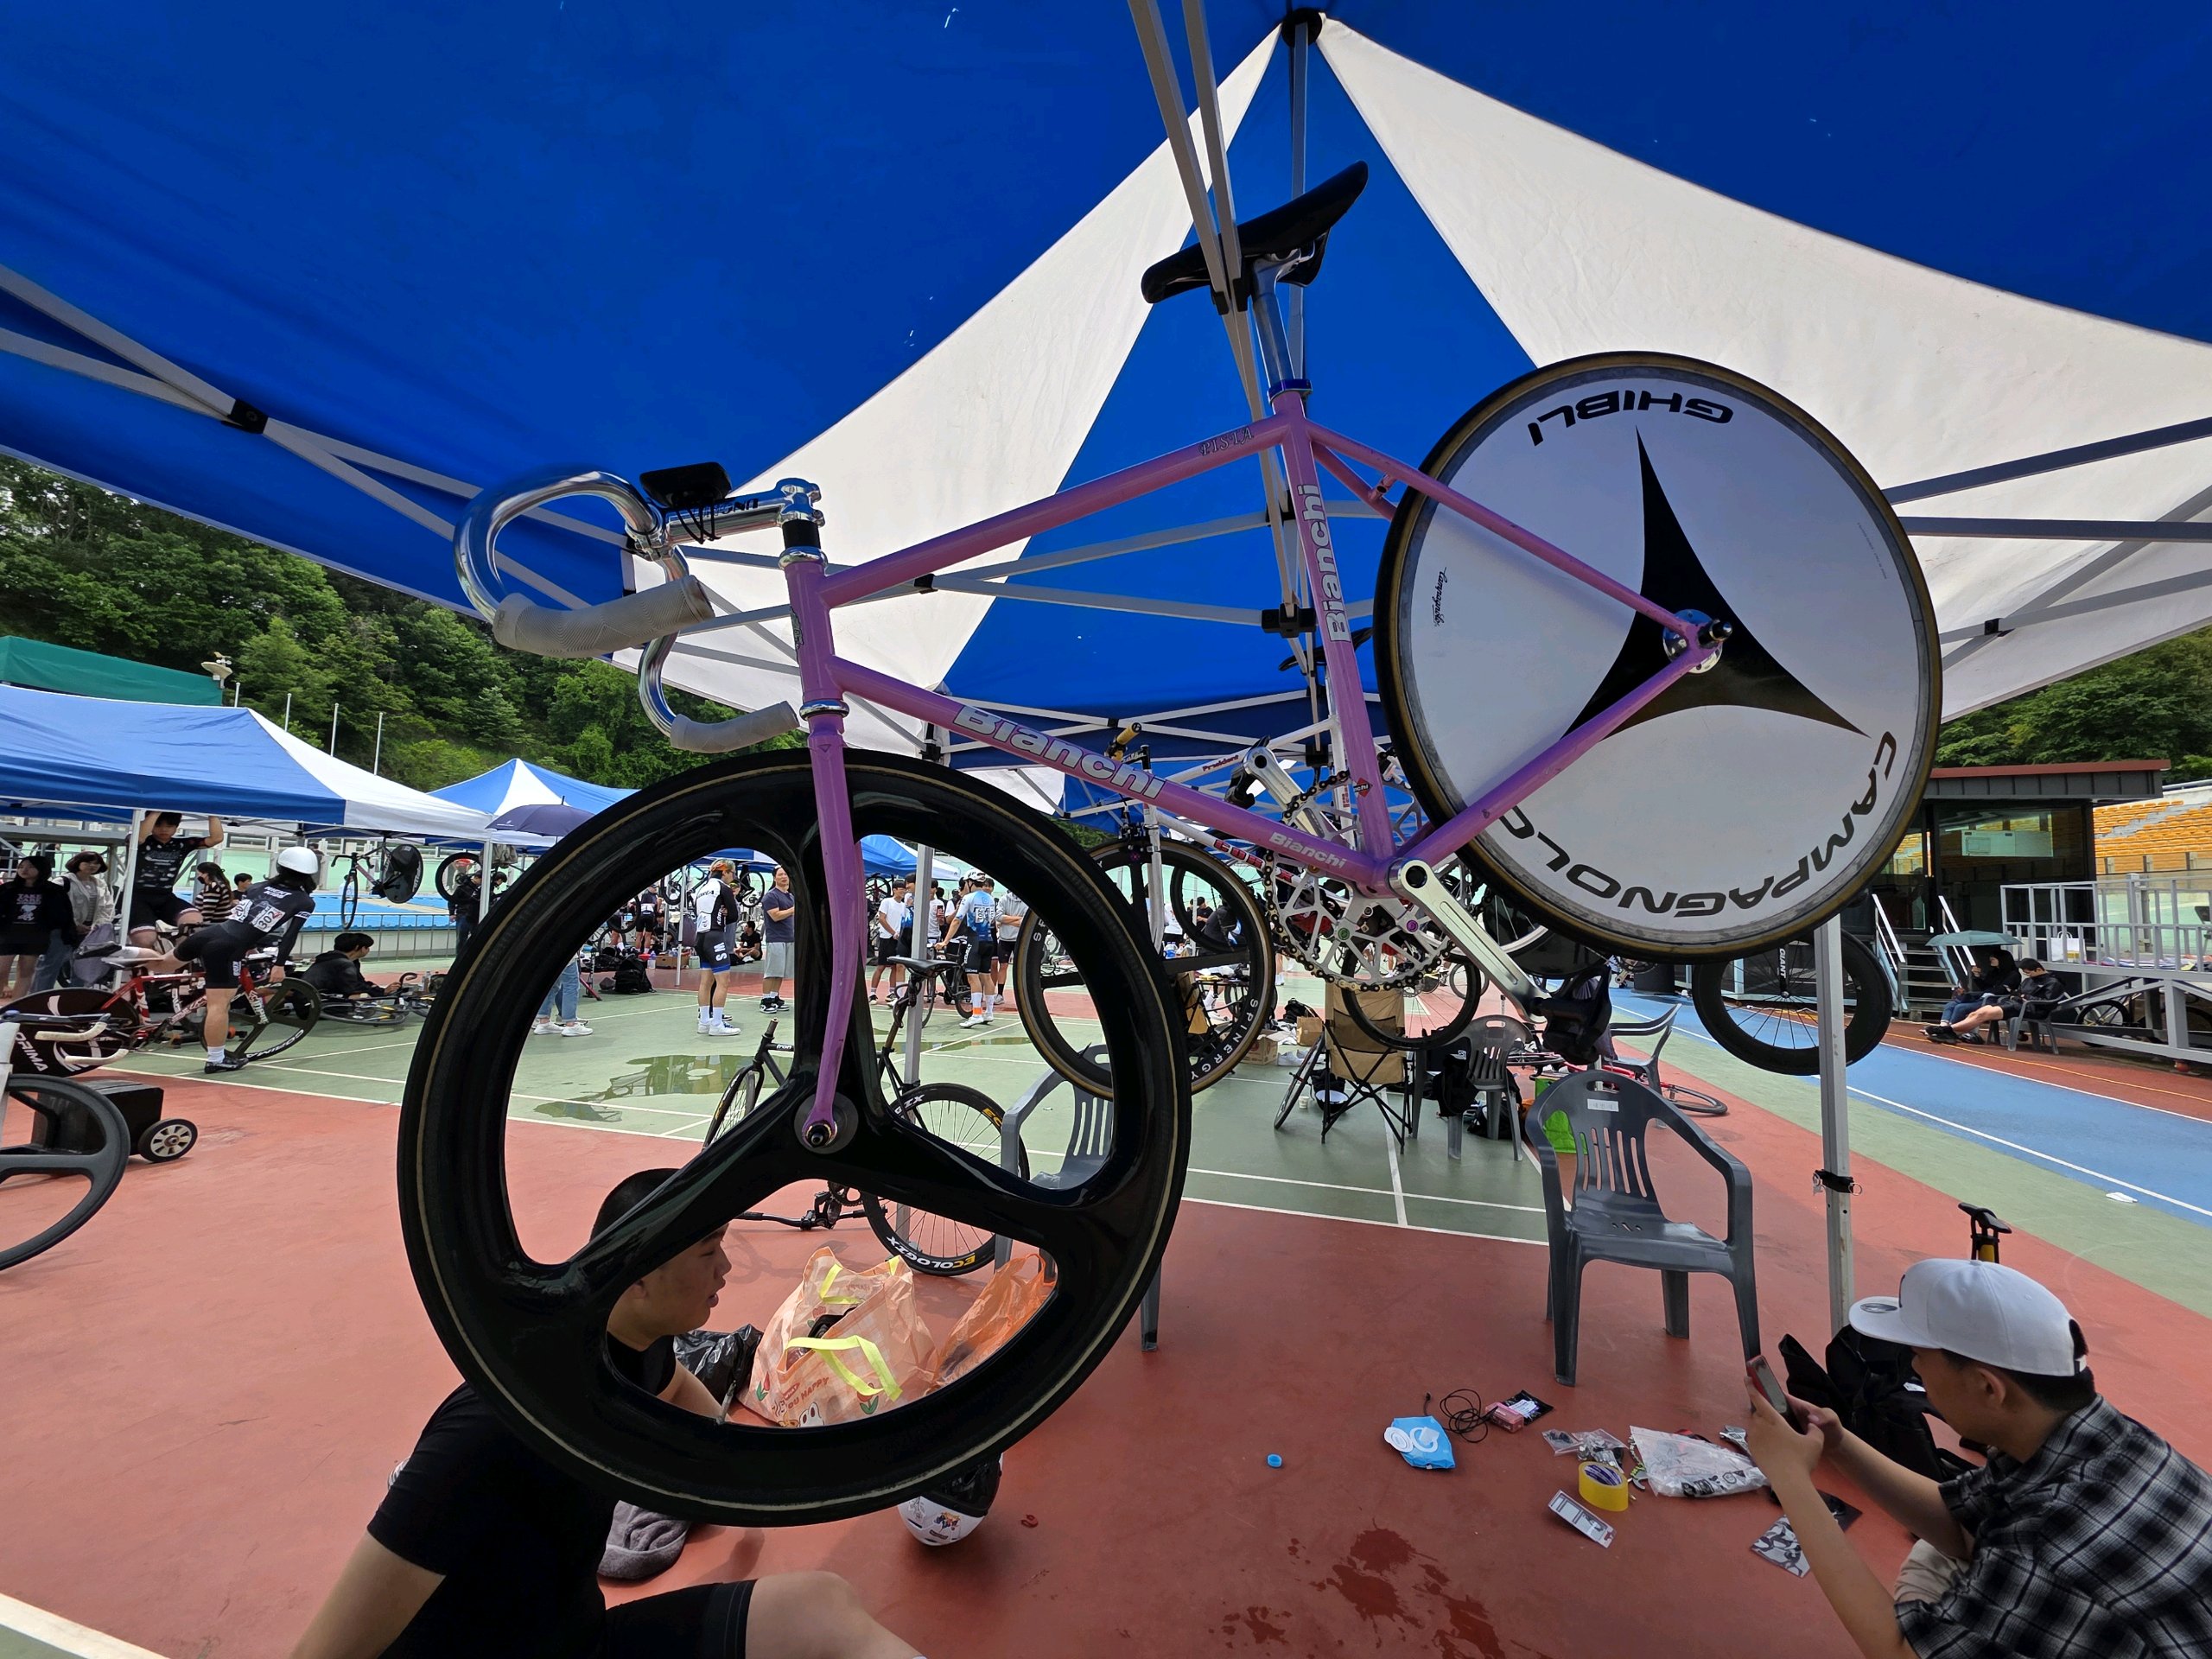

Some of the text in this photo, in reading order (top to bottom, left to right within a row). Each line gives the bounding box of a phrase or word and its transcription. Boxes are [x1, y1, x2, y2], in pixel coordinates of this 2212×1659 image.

[1528, 390, 1733, 447] GHIBLI
[1198, 427, 1254, 456] PISTA
[1298, 485, 1351, 642] Bianchi
[953, 705, 1166, 799] Bianchi
[1213, 839, 1294, 882] CORX
[1269, 832, 1346, 868] Bianchi
[258, 910, 276, 930] 302
[15, 1032, 48, 1071] ORIMA
[246, 1029, 304, 1058] CORIMA
[1190, 999, 1258, 1080] SPINERGY
[886, 1236, 976, 1268] ECOLOGIX
[801, 1377, 830, 1400] HAPPY
